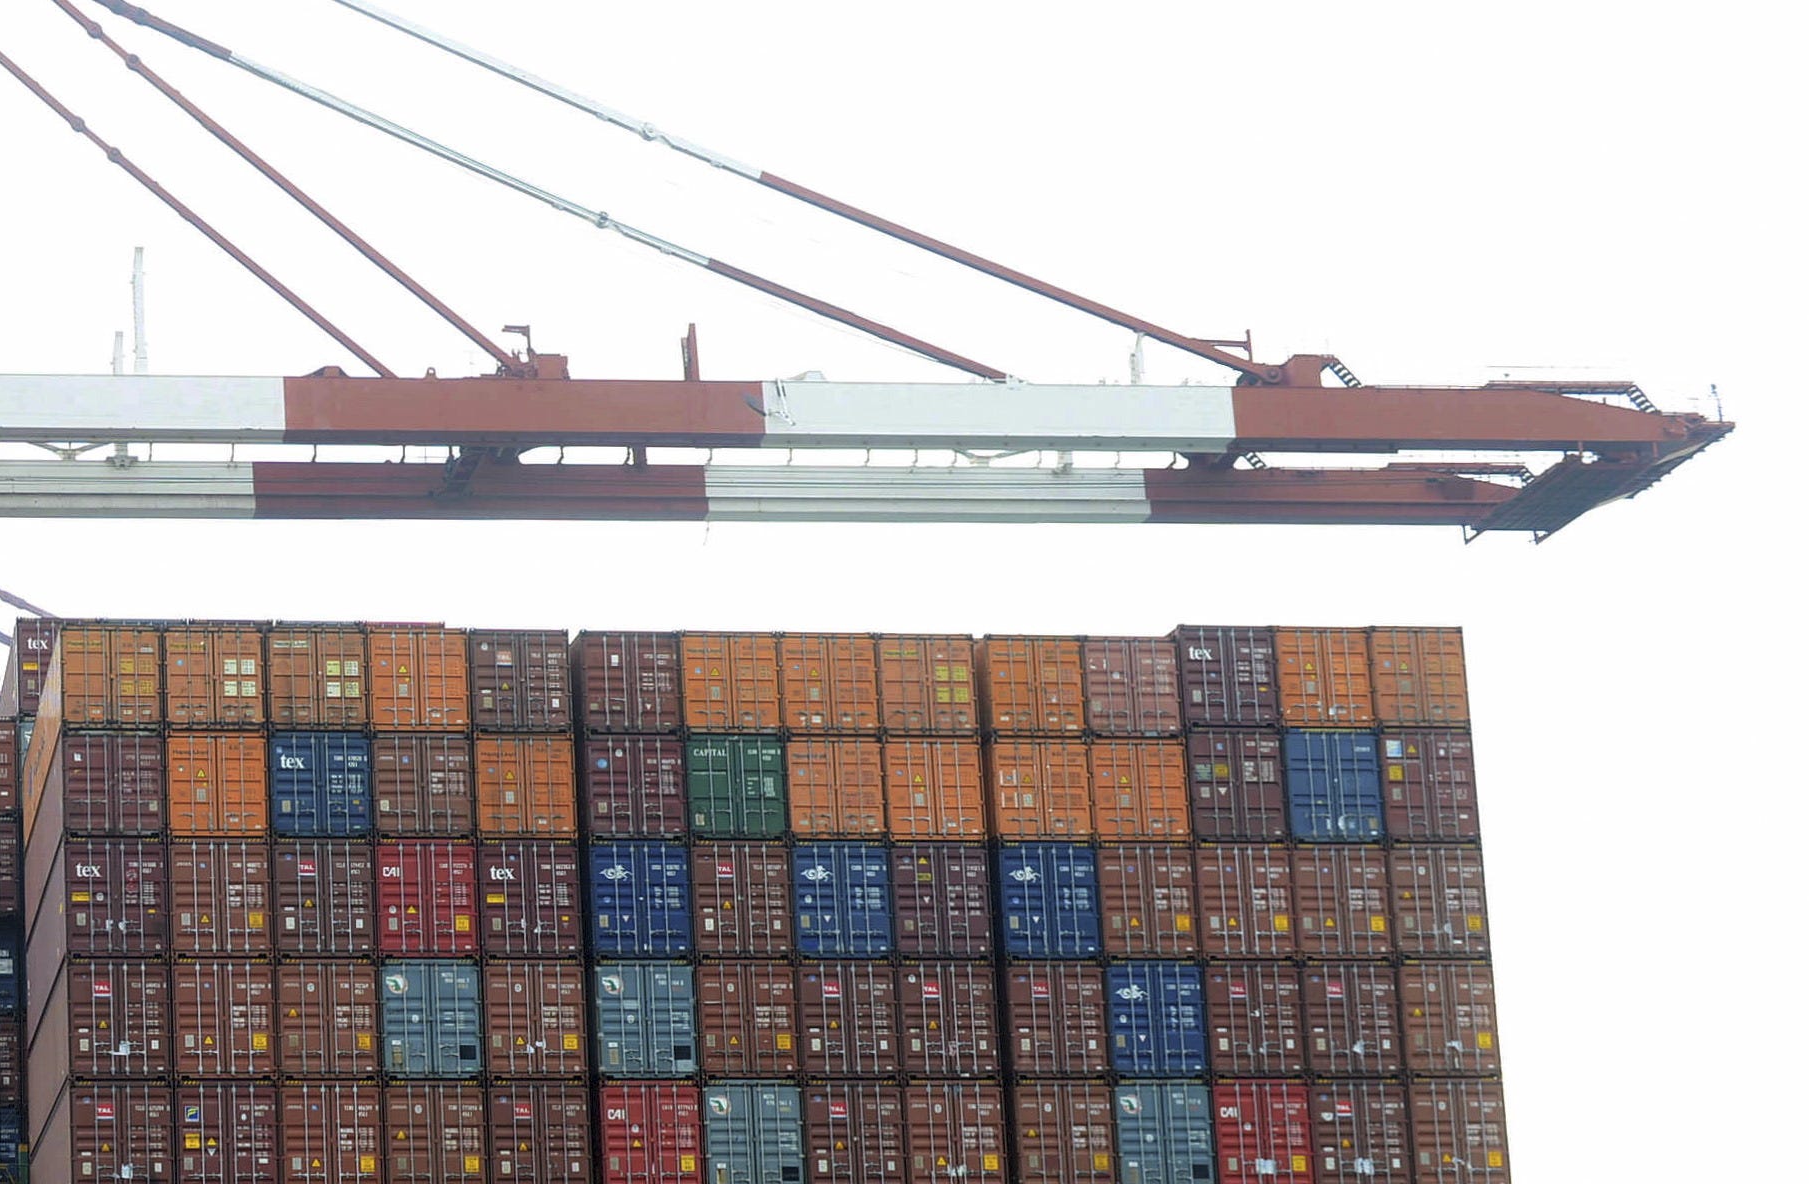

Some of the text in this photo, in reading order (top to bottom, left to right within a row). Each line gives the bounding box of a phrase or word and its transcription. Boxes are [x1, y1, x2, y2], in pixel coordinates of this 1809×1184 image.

[27, 638, 48, 650] tex
[1189, 645, 1212, 660] tex
[693, 748, 727, 756] CAPITAL
[280, 753, 305, 769] tex
[76, 863, 102, 878] tex
[490, 866, 516, 881] tex
[608, 1109, 625, 1120] CAI
